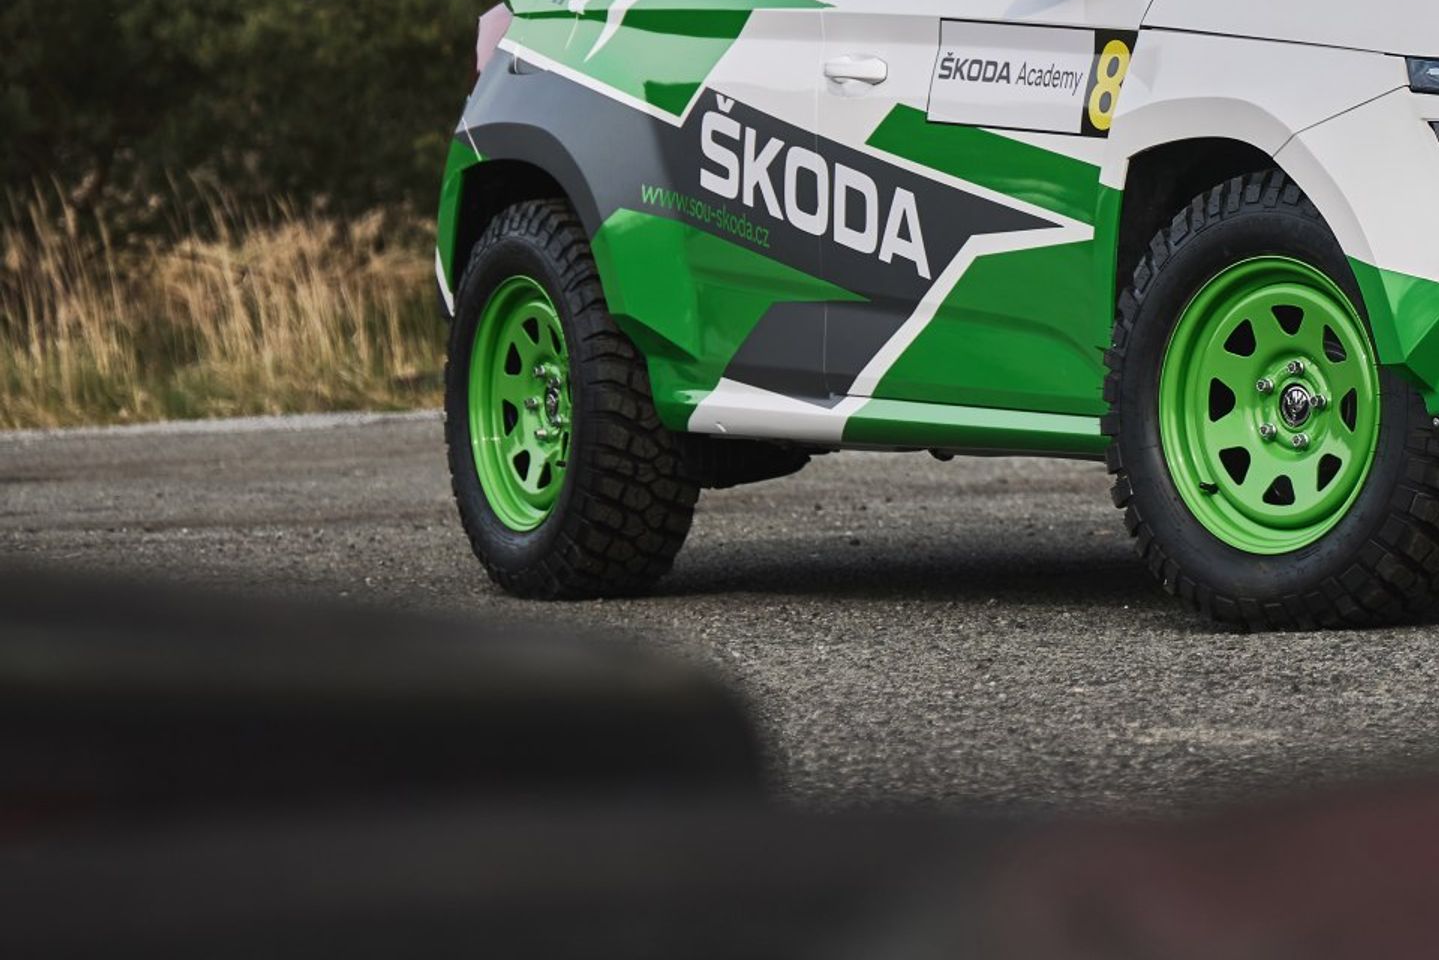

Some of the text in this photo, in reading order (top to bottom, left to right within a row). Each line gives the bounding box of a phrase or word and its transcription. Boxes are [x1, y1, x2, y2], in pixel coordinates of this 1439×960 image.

[938, 51, 1083, 96] ŠKODA Academy
[1088, 39, 1131, 130] 8
[641, 183, 770, 248] www.sou-skoda.cz
[699, 93, 932, 280] ŠKODA
